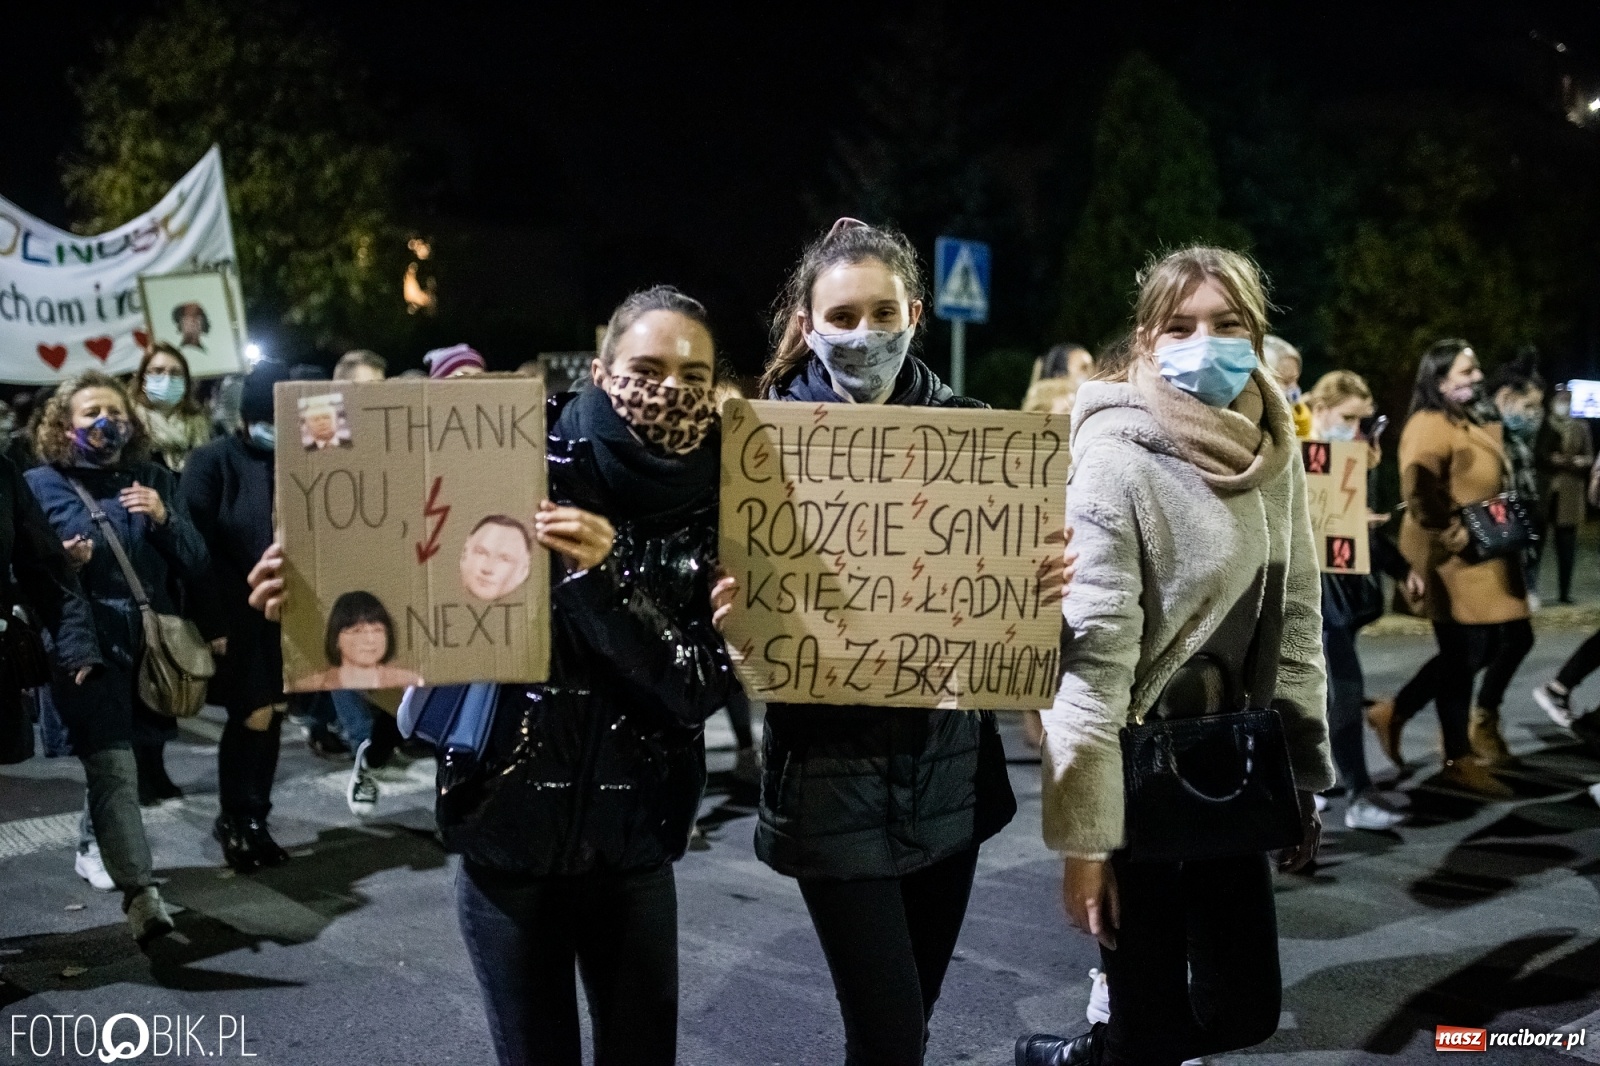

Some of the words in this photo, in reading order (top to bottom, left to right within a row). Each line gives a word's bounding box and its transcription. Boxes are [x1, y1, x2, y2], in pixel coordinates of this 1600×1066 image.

[362, 403, 537, 453] THANK
[740, 423, 901, 484] CHCECIE
[912, 424, 1061, 503] DZIECI?
[290, 468, 408, 539] YOU,
[746, 565, 895, 623] KSIĘŻA
[405, 602, 524, 651] NEXT
[757, 633, 825, 699] SĄ
[842, 638, 879, 691] Z
[884, 632, 1058, 699] BRZUCHAMI
